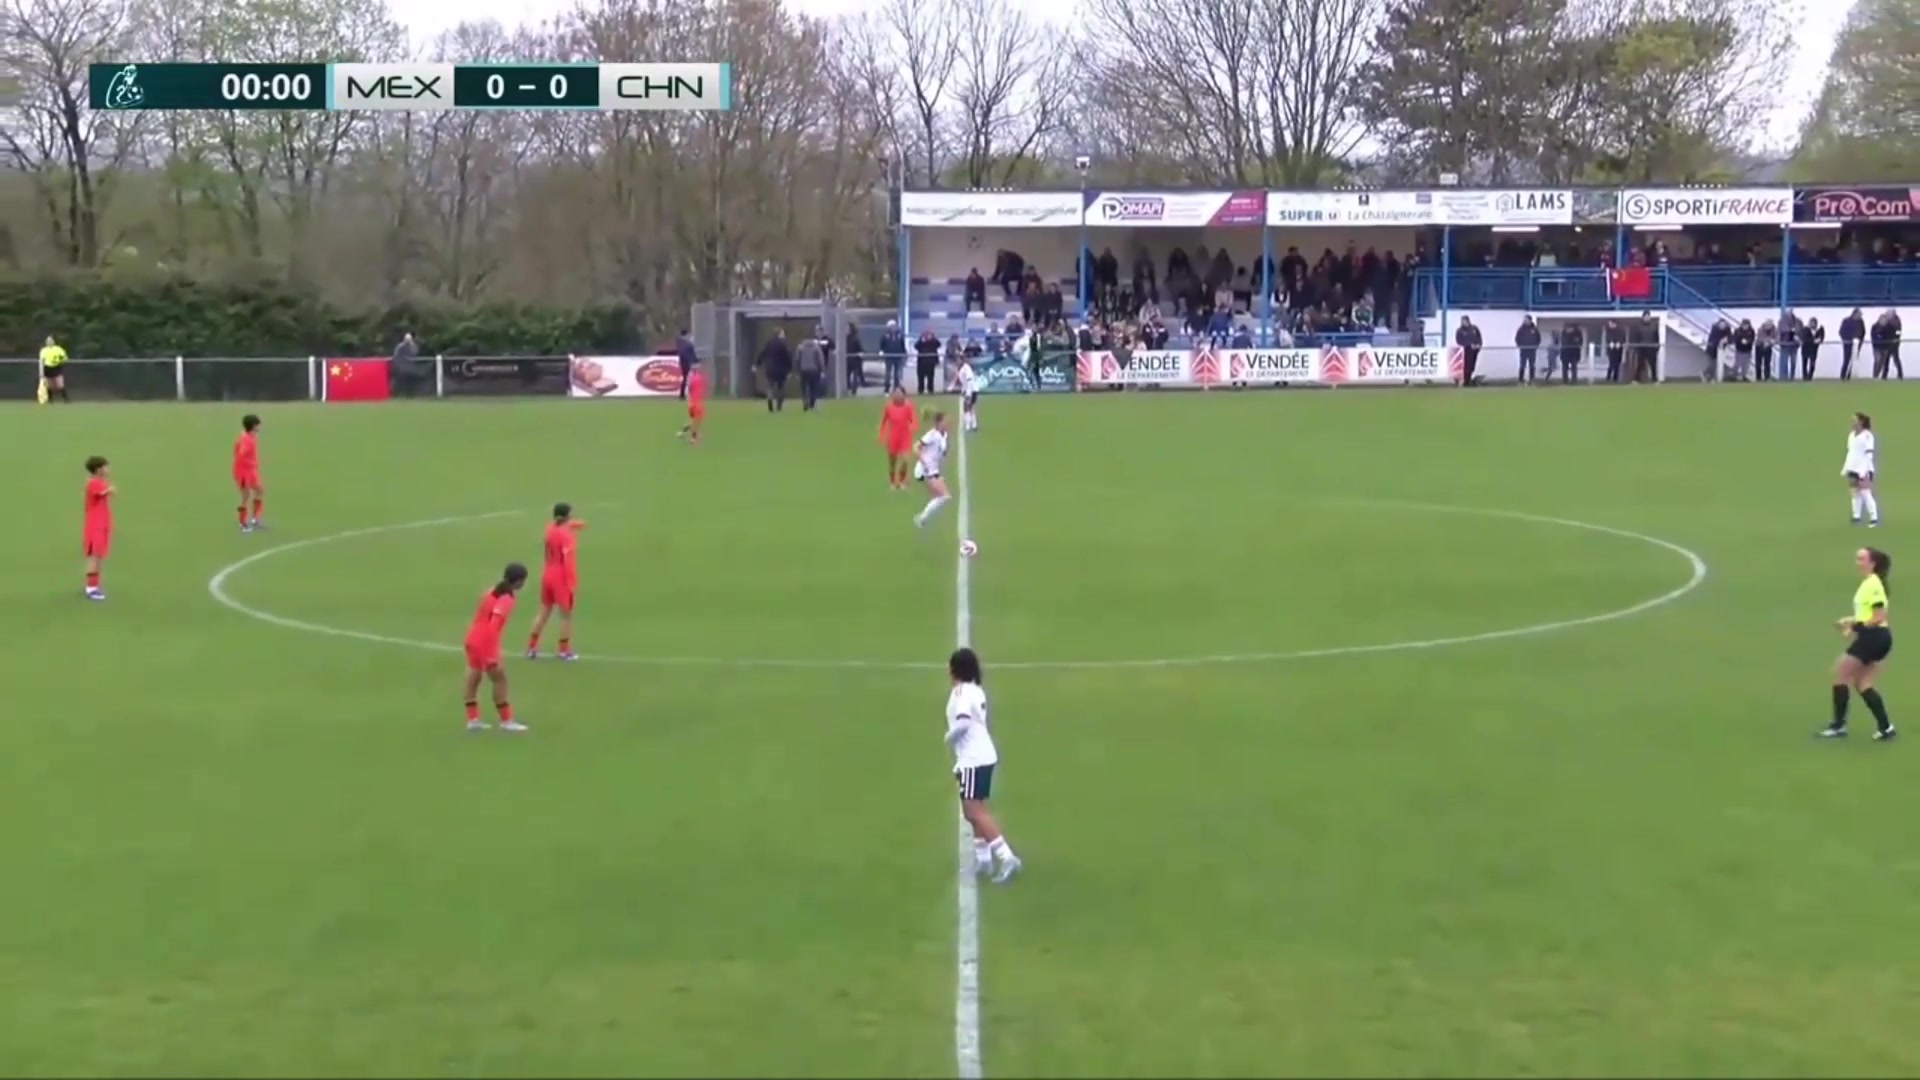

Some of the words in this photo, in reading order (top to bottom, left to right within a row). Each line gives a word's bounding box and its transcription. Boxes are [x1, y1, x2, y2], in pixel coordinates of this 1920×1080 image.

[1516, 193, 1565, 210] LAMS
[1279, 210, 1323, 221] SUPER
[1246, 351, 1309, 369] VENDÉE
[1374, 350, 1438, 368] VENDÉE
